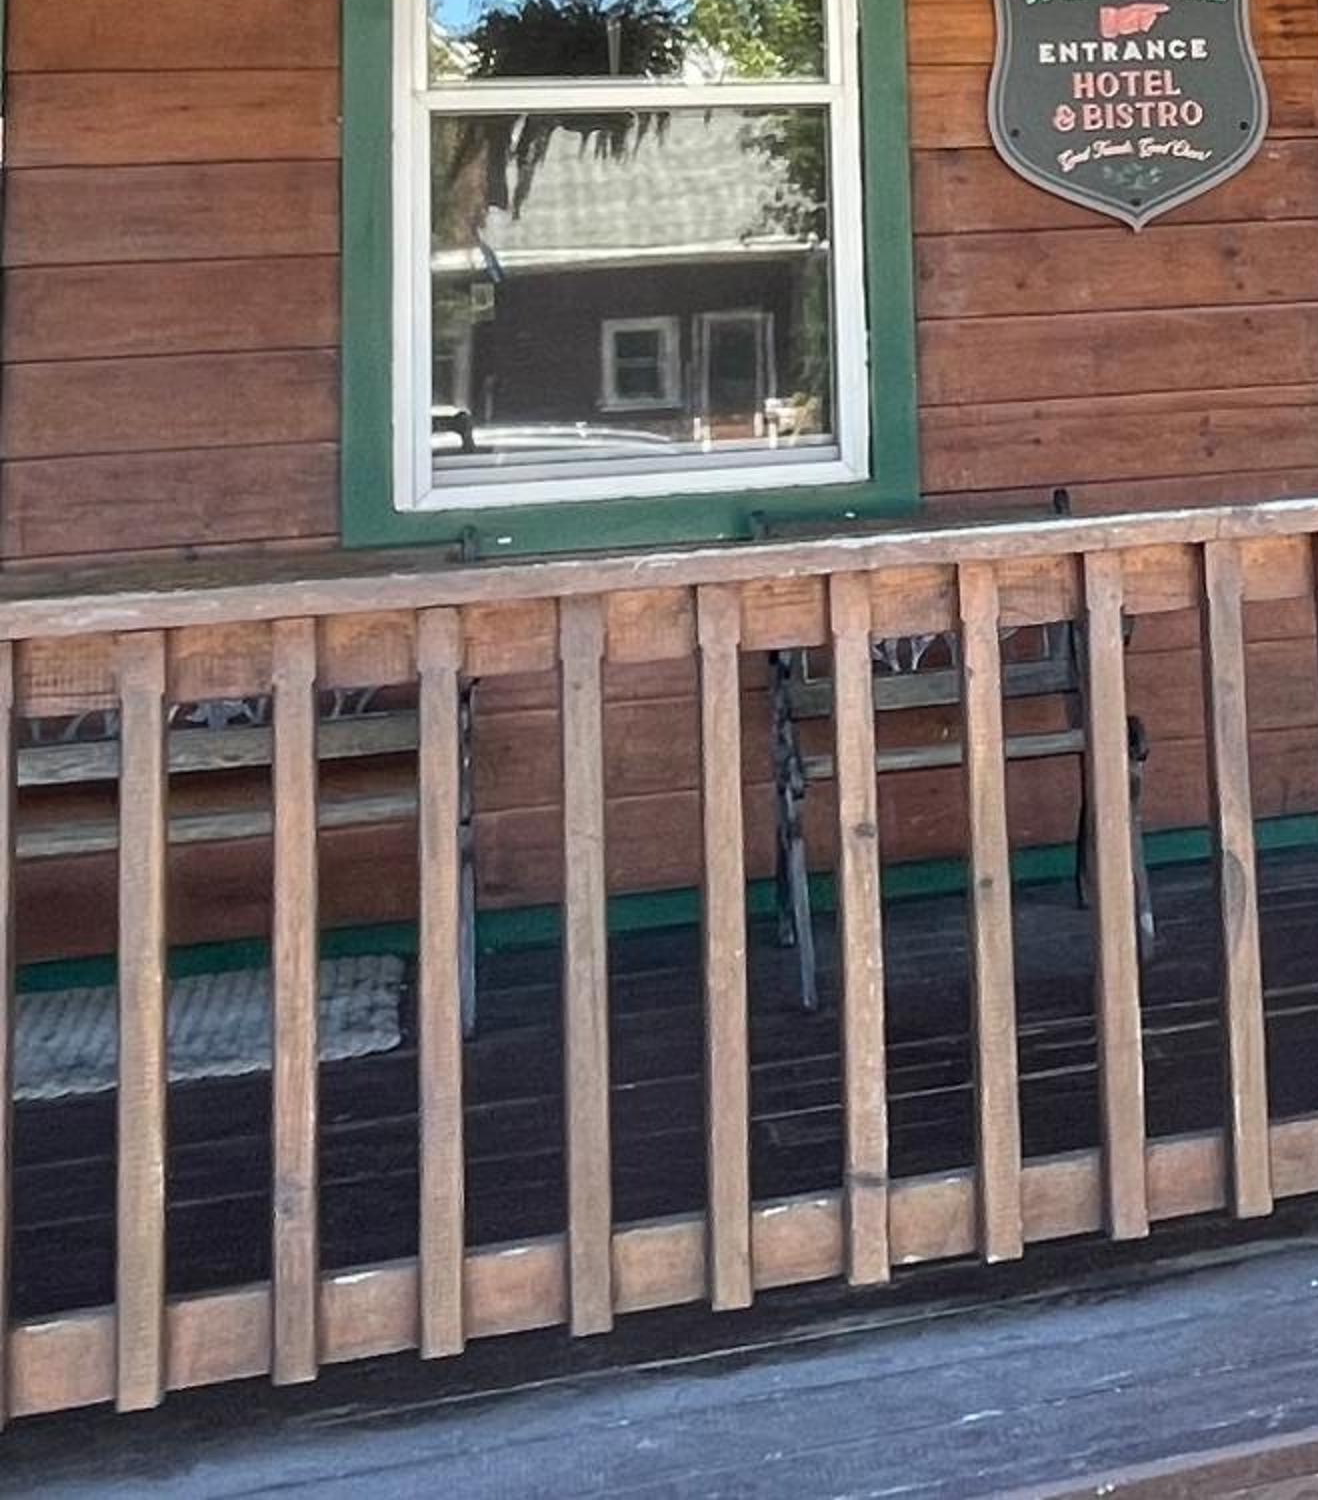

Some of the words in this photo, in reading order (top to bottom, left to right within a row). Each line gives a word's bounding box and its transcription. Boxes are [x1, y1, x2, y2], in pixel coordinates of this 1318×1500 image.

[1039, 38, 1208, 64] ENTRANCE
[1072, 69, 1181, 100] HOTEL
[1053, 104, 1076, 132] &
[1083, 100, 1204, 131] BISTRO
